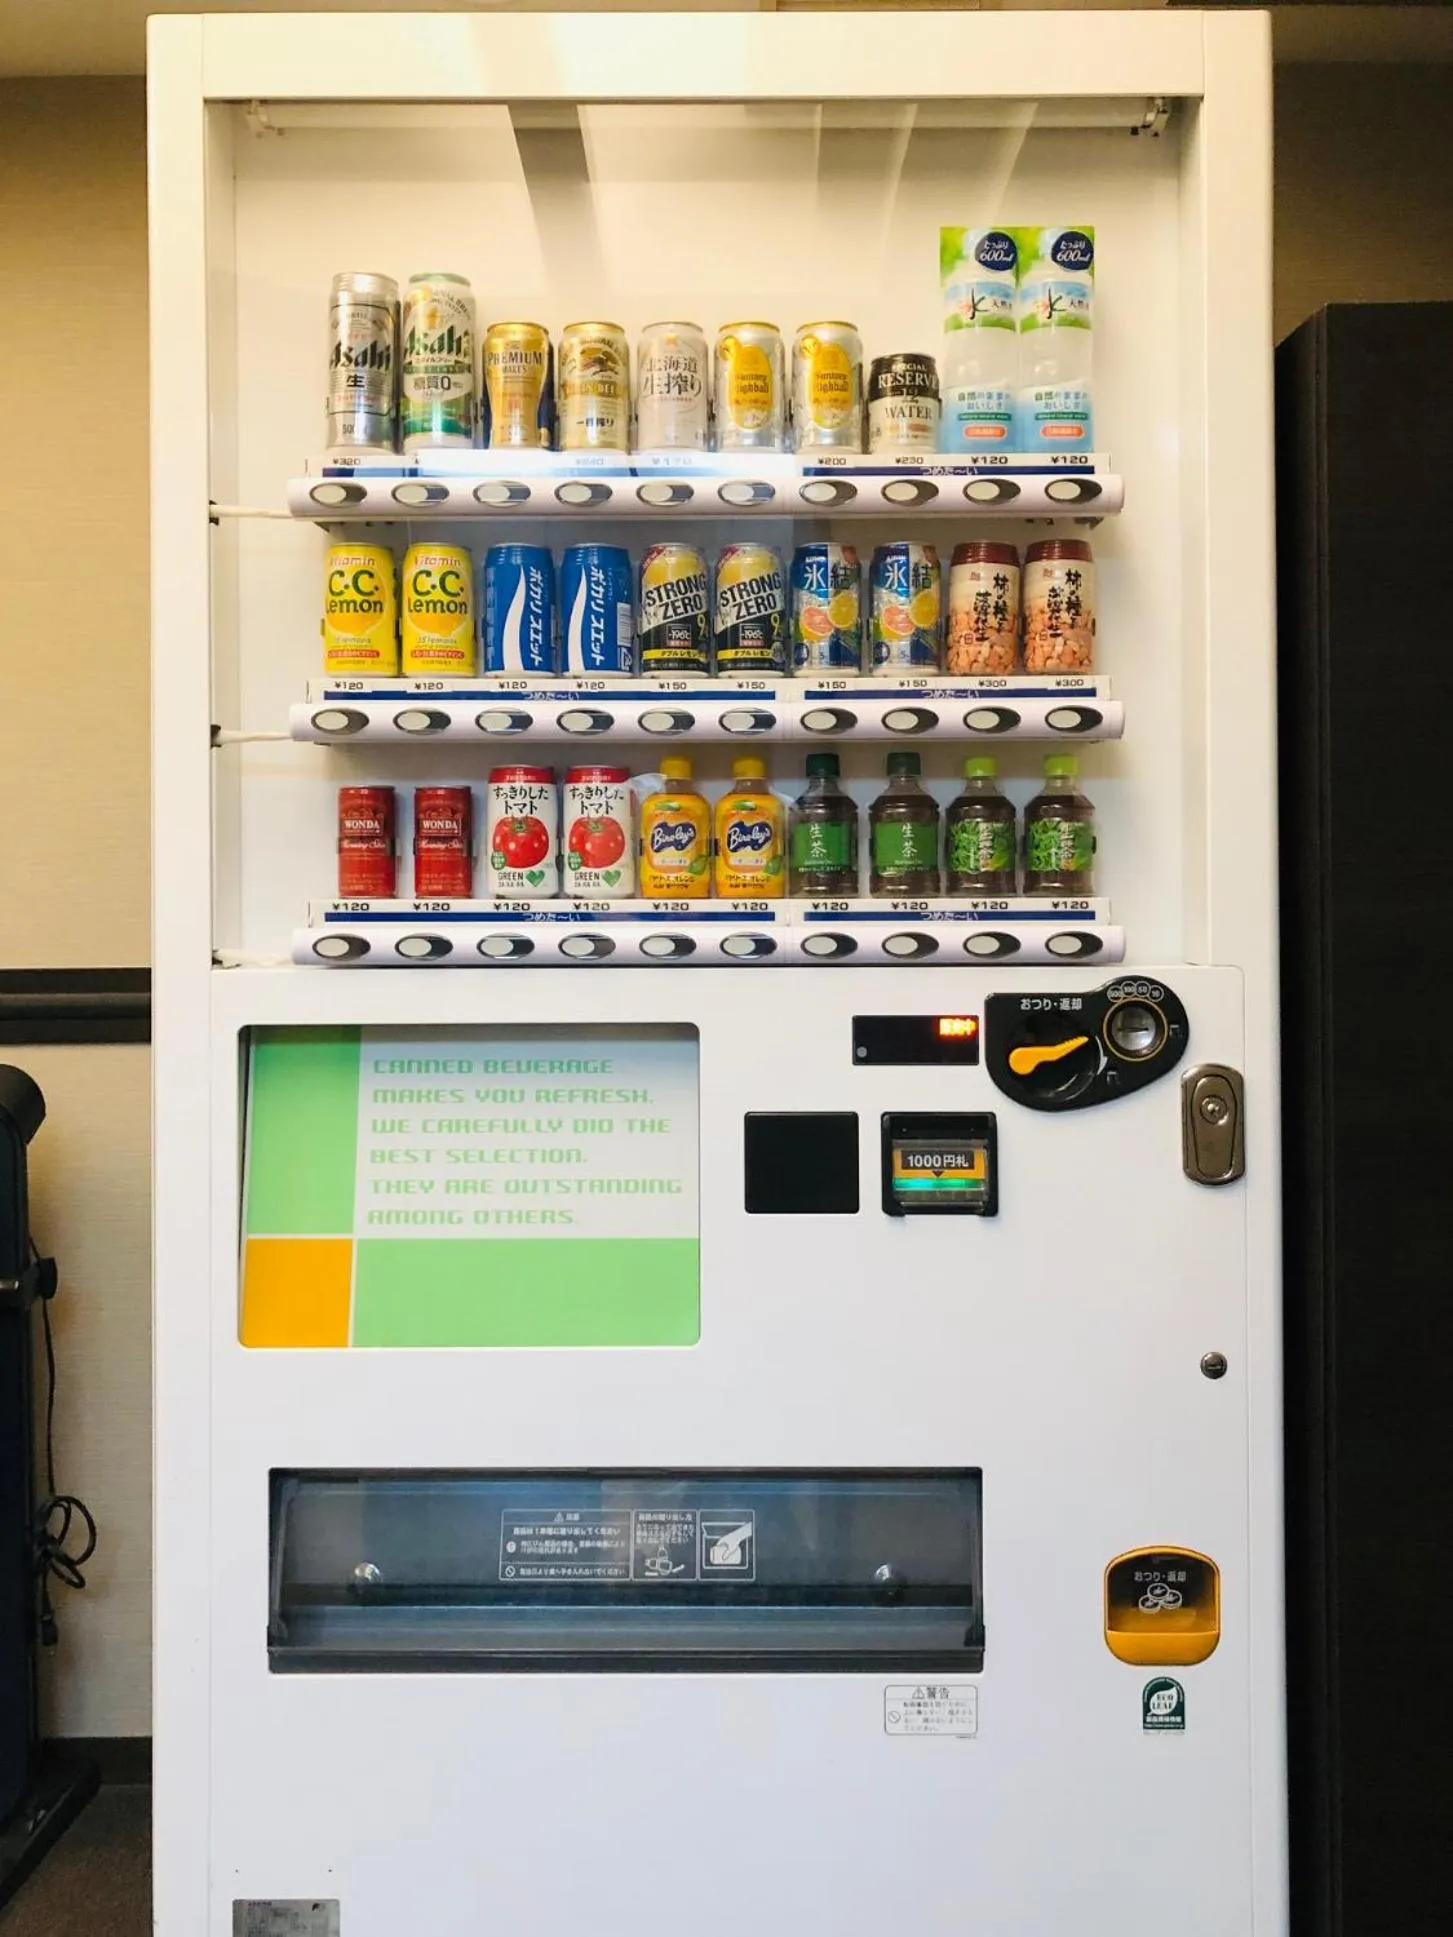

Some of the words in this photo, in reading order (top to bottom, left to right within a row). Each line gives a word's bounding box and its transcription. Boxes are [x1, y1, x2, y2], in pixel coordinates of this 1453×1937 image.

[979, 250, 1012, 262] 600ml
[1056, 250, 1090, 262] 600ml
[402, 325, 463, 358] Asahi
[329, 340, 391, 371] Asahi
[487, 350, 542, 365] PREMIUM
[646, 356, 698, 373] 北海道
[346, 374, 365, 388] 生
[643, 372, 702, 398] 生搾り
[885, 405, 933, 420] WATER
[818, 457, 847, 466] ¥200
[895, 456, 924, 466] ¥230
[971, 456, 1008, 464] ¥120
[1051, 455, 1088, 464] ¥120
[804, 564, 850, 591] 氷結
[885, 562, 932, 590] 氷結
[645, 573, 707, 607] STRONG
[720, 572, 781, 608] STRONG
[659, 594, 703, 621] ZERO
[732, 592, 777, 621] ZERO
[530, 566, 543, 667] ポカリスエット
[591, 566, 605, 667] ポカリスエット
[335, 681, 364, 690] ¥120
[415, 682, 444, 690] ¥120
[499, 681, 527, 689] ¥120
[576, 681, 605, 689] ¥120
[658, 682, 687, 690] ¥150
[737, 681, 766, 689] ¥150
[818, 681, 847, 689] ¥150
[899, 680, 928, 688] ¥150
[978, 680, 1007, 688] ¥300
[1055, 679, 1084, 687] ¥300
[493, 786, 549, 800] すっきりした
[569, 786, 624, 800] すっきりした
[504, 801, 538, 815] トマト
[580, 801, 614, 815] トマト
[344, 819, 380, 829] WONDA
[422, 820, 458, 829] WONDA
[810, 823, 827, 857] 生茶
[901, 823, 917, 857] 生茶
[497, 872, 524, 880] GREEN
[574, 872, 600, 880] GREEN
[332, 903, 370, 911] ¥120
[413, 903, 450, 911] ¥120
[493, 903, 530, 911] ¥120
[573, 903, 610, 911] ¥120
[891, 902, 928, 910] ¥120
[1052, 901, 1089, 909] ¥120
[1020, 997, 1082, 1011] おつり・返却
[373, 1059, 473, 1074] CANNED
[483, 1059, 614, 1074] BEVERAGE
[373, 1089, 464, 1104] MAKES
[475, 1089, 525, 1103] YOU
[535, 1089, 653, 1104] REFRESH.
[372, 1119, 410, 1133] WE
[422, 1119, 563, 1133] CAREFULLY
[573, 1119, 613, 1133] DID
[626, 1119, 671, 1133] THE
[370, 1148, 434, 1164] BEST
[446, 1148, 587, 1164] SELECTION.
[907, 1153, 969, 1168] 1000円札
[371, 1179, 434, 1194] THEY
[445, 1179, 493, 1194] ARE
[504, 1179, 683, 1194] OUTSTANDING
[368, 1209, 463, 1225] AMONG
[926, 1687, 949, 1700] 警告
